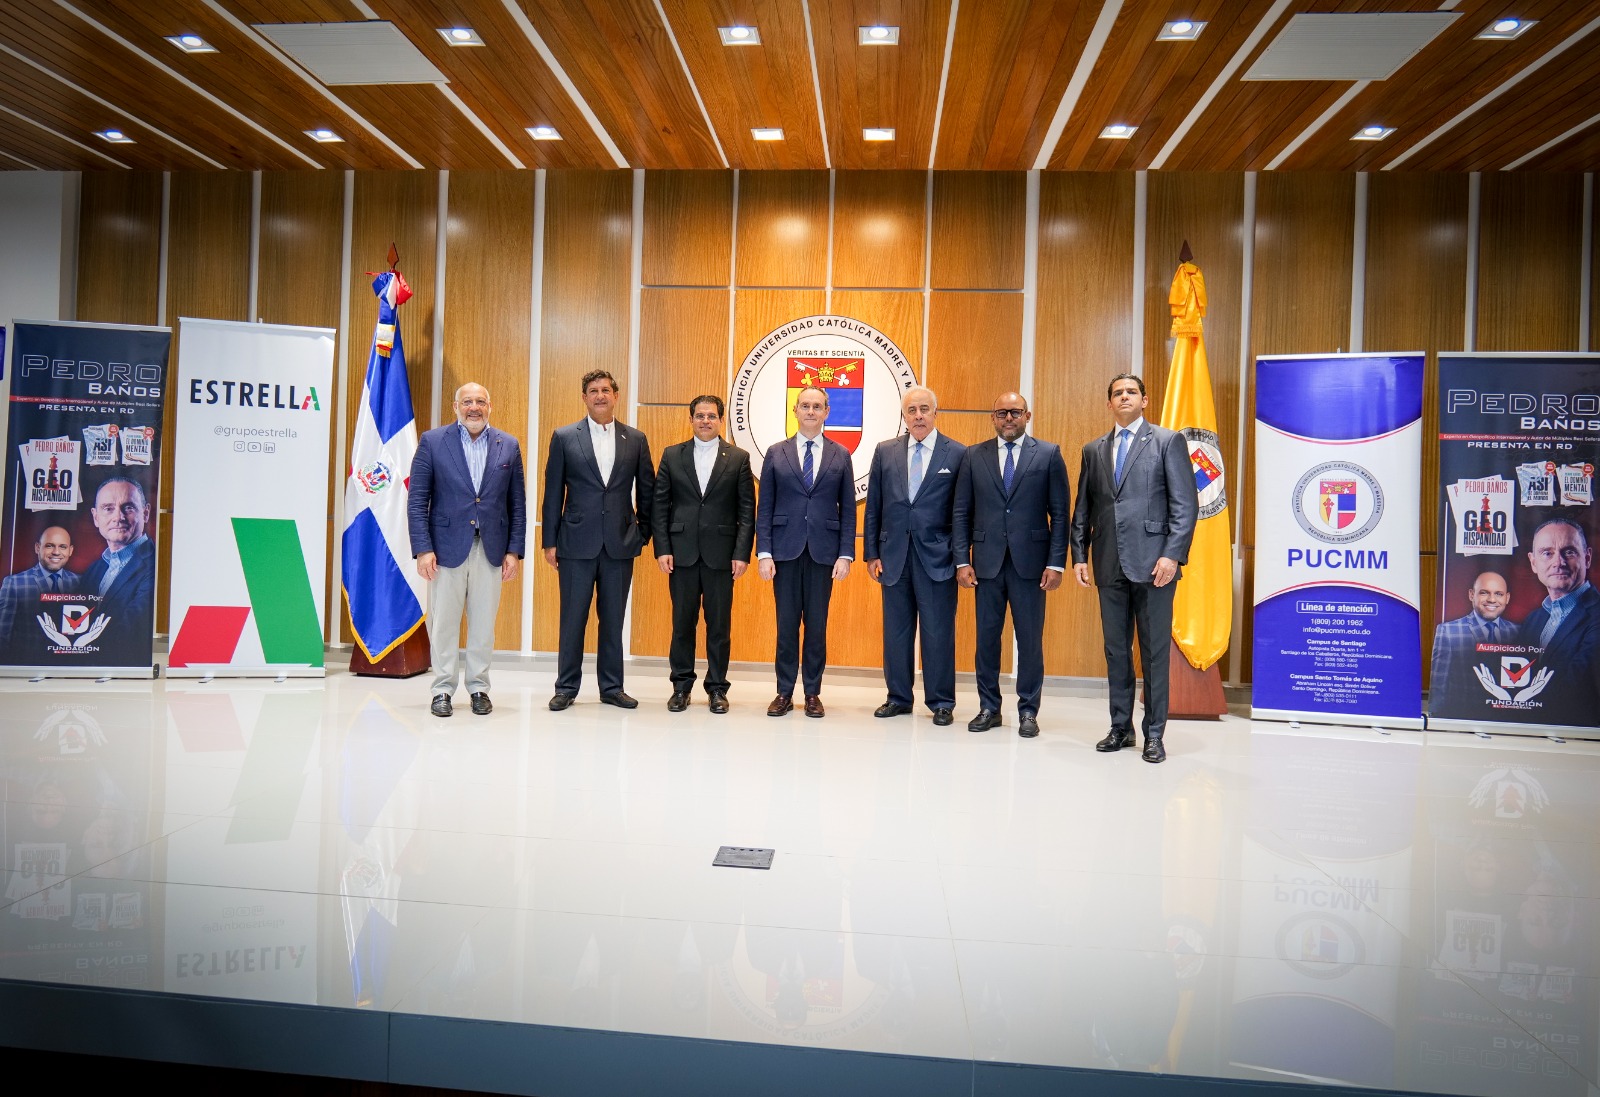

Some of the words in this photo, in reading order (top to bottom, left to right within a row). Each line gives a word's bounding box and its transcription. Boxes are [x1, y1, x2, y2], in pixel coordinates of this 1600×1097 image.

[21, 354, 162, 384] PEDRO
[737, 369, 753, 431] PONTIFICIA
[751, 320, 814, 366] UNIVERSIDAD
[818, 318, 872, 338] CATÓLICA
[874, 336, 905, 368] MADRE
[88, 382, 161, 398] BAÑOS
[190, 379, 321, 411] ESTRELLA
[39, 404, 96, 413] PRESENTA
[1448, 389, 1600, 415] PEDRO
[1521, 416, 1600, 430] BAÑOS
[214, 425, 297, 438] @grupoestrella
[35, 441, 52, 452] PEDRO
[56, 441, 75, 453] BAÑOS
[126, 445, 148, 453] MENTAL
[33, 468, 73, 489] GEO
[1465, 481, 1485, 493] PEDRO
[1487, 481, 1508, 493] BAÑOS
[1565, 484, 1587, 492] MENTAL
[32, 489, 71, 502] HISPANIDAD
[1464, 510, 1507, 532] GEO
[1464, 532, 1506, 546] HISPANIDAD
[1287, 548, 1388, 569] PUCMM
[42, 594, 86, 602] Auspiciado
[1301, 603, 1323, 611] Línea
[1325, 604, 1335, 612] de
[1337, 604, 1373, 613] atención
[1303, 627, 1371, 635] info@pucmm.edu.do
[1477, 644, 1526, 653] Auspiciado
[1528, 646, 1545, 654] Por:
